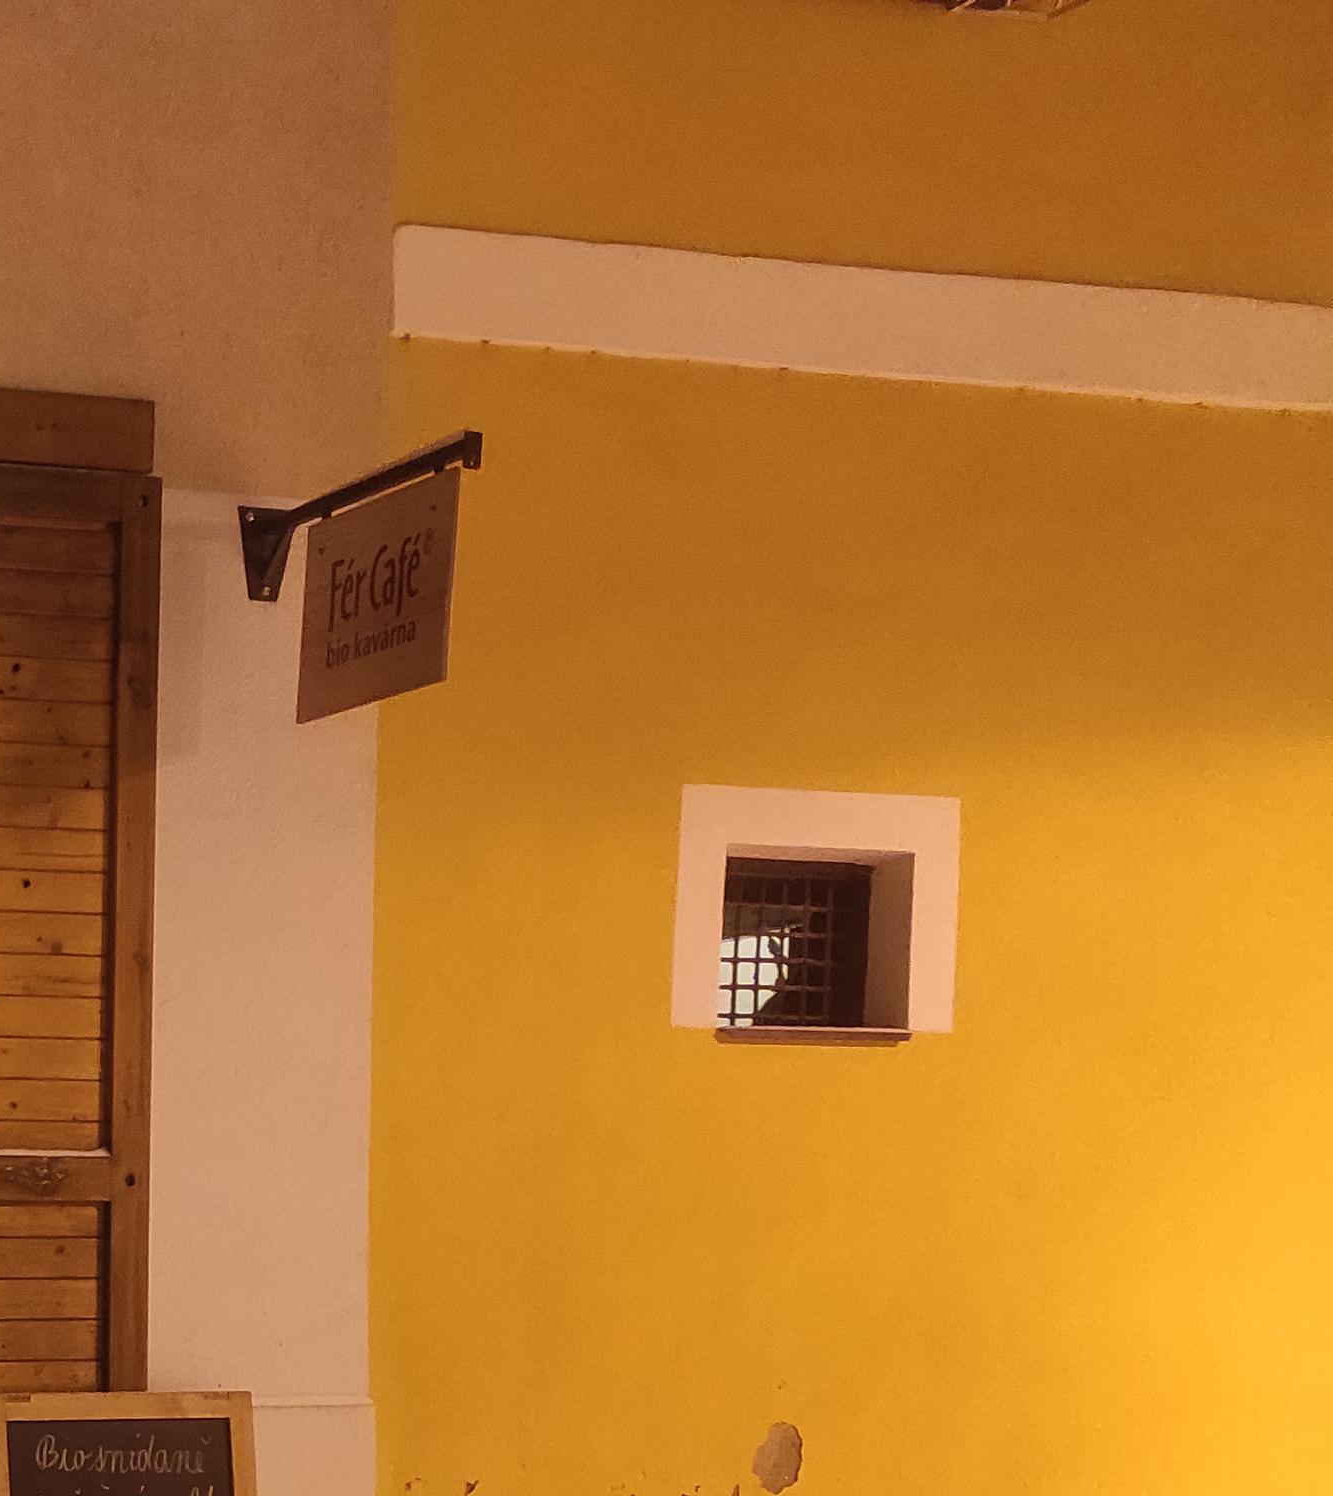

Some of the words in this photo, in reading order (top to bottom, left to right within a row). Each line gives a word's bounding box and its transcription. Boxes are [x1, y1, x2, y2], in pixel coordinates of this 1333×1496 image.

[327, 558, 367, 633] Fér
[369, 531, 422, 618] Café
[325, 640, 350, 668] bio
[353, 620, 417, 660] kavárna
